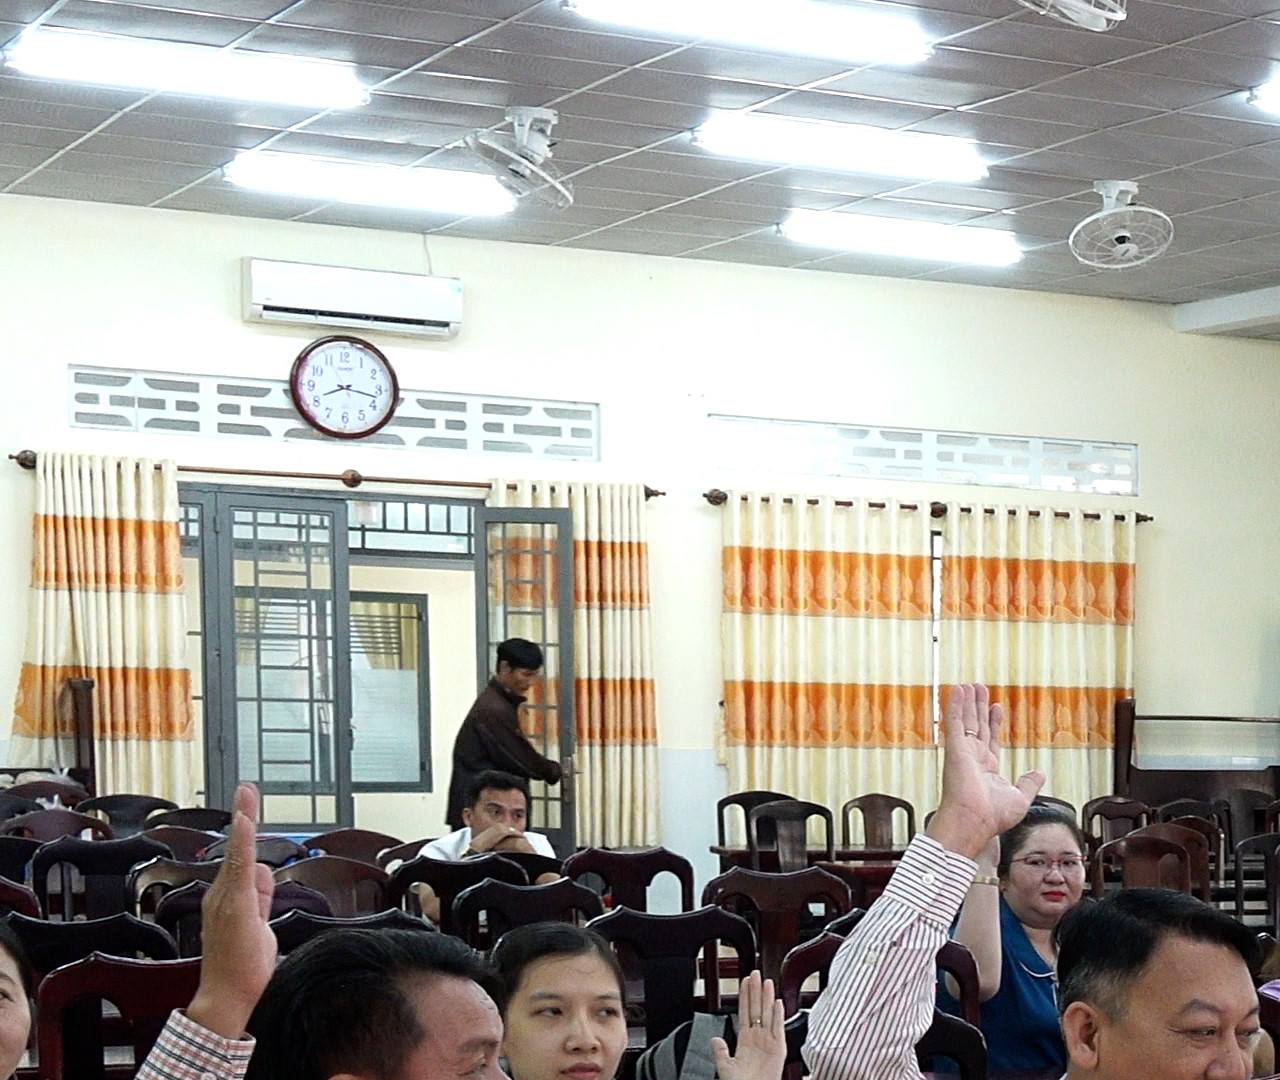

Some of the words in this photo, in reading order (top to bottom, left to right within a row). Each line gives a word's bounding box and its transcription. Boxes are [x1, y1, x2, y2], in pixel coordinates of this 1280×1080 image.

[325, 354, 333, 366] 11
[340, 352, 350, 363] 12
[312, 366, 323, 376] 10
[371, 368, 377, 380] 2
[307, 380, 315, 391] 9
[313, 396, 320, 407] 8
[369, 400, 377, 411] 4
[325, 407, 332, 418] 7
[341, 412, 349, 424] 6
[358, 410, 365, 421] 5
